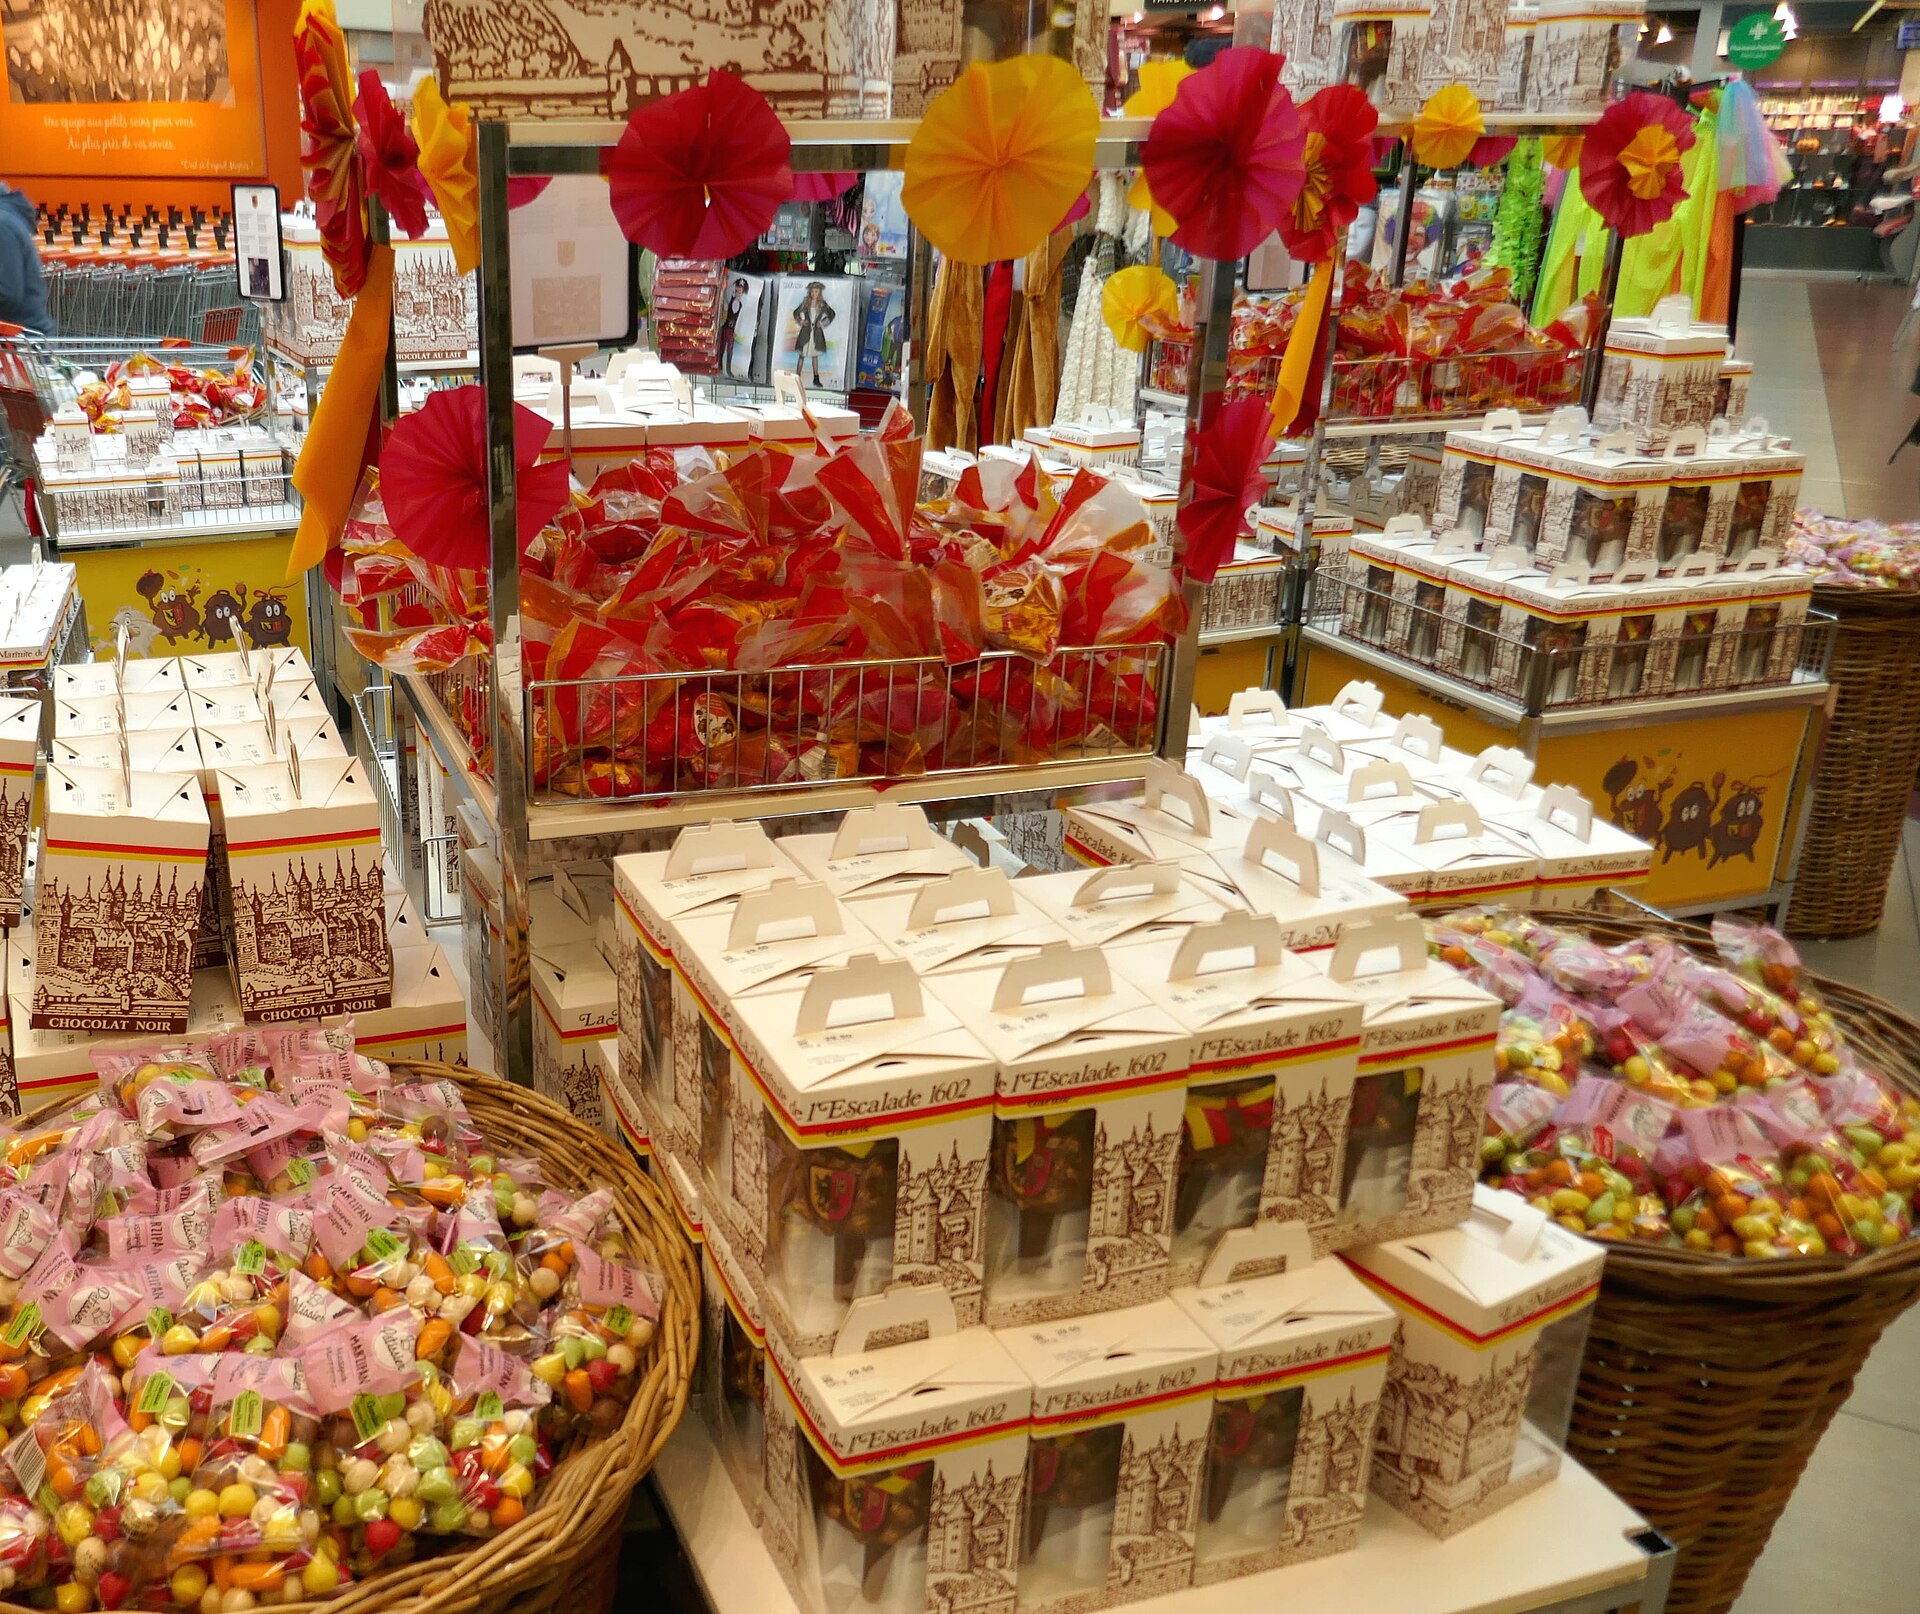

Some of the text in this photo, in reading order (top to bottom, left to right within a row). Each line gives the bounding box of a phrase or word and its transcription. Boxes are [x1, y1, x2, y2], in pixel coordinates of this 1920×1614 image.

[310, 357, 336, 365] CHOCO
[397, 351, 462, 360] HOCOLAT AU LAIT
[196, 956, 208, 966] IR
[260, 998, 377, 1022] CHOCOLAT NOIR
[49, 1017, 172, 1032] CHOCOLAT NOIR
[1305, 1020, 1343, 1042] 1602
[1452, 1013, 1486, 1033] 1602
[1127, 1052, 1167, 1074] 1602
[929, 1078, 970, 1104] 1602
[1334, 1331, 1373, 1353] 1602
[1156, 1367, 1197, 1389] 1602
[965, 1403, 1009, 1427] 1602
